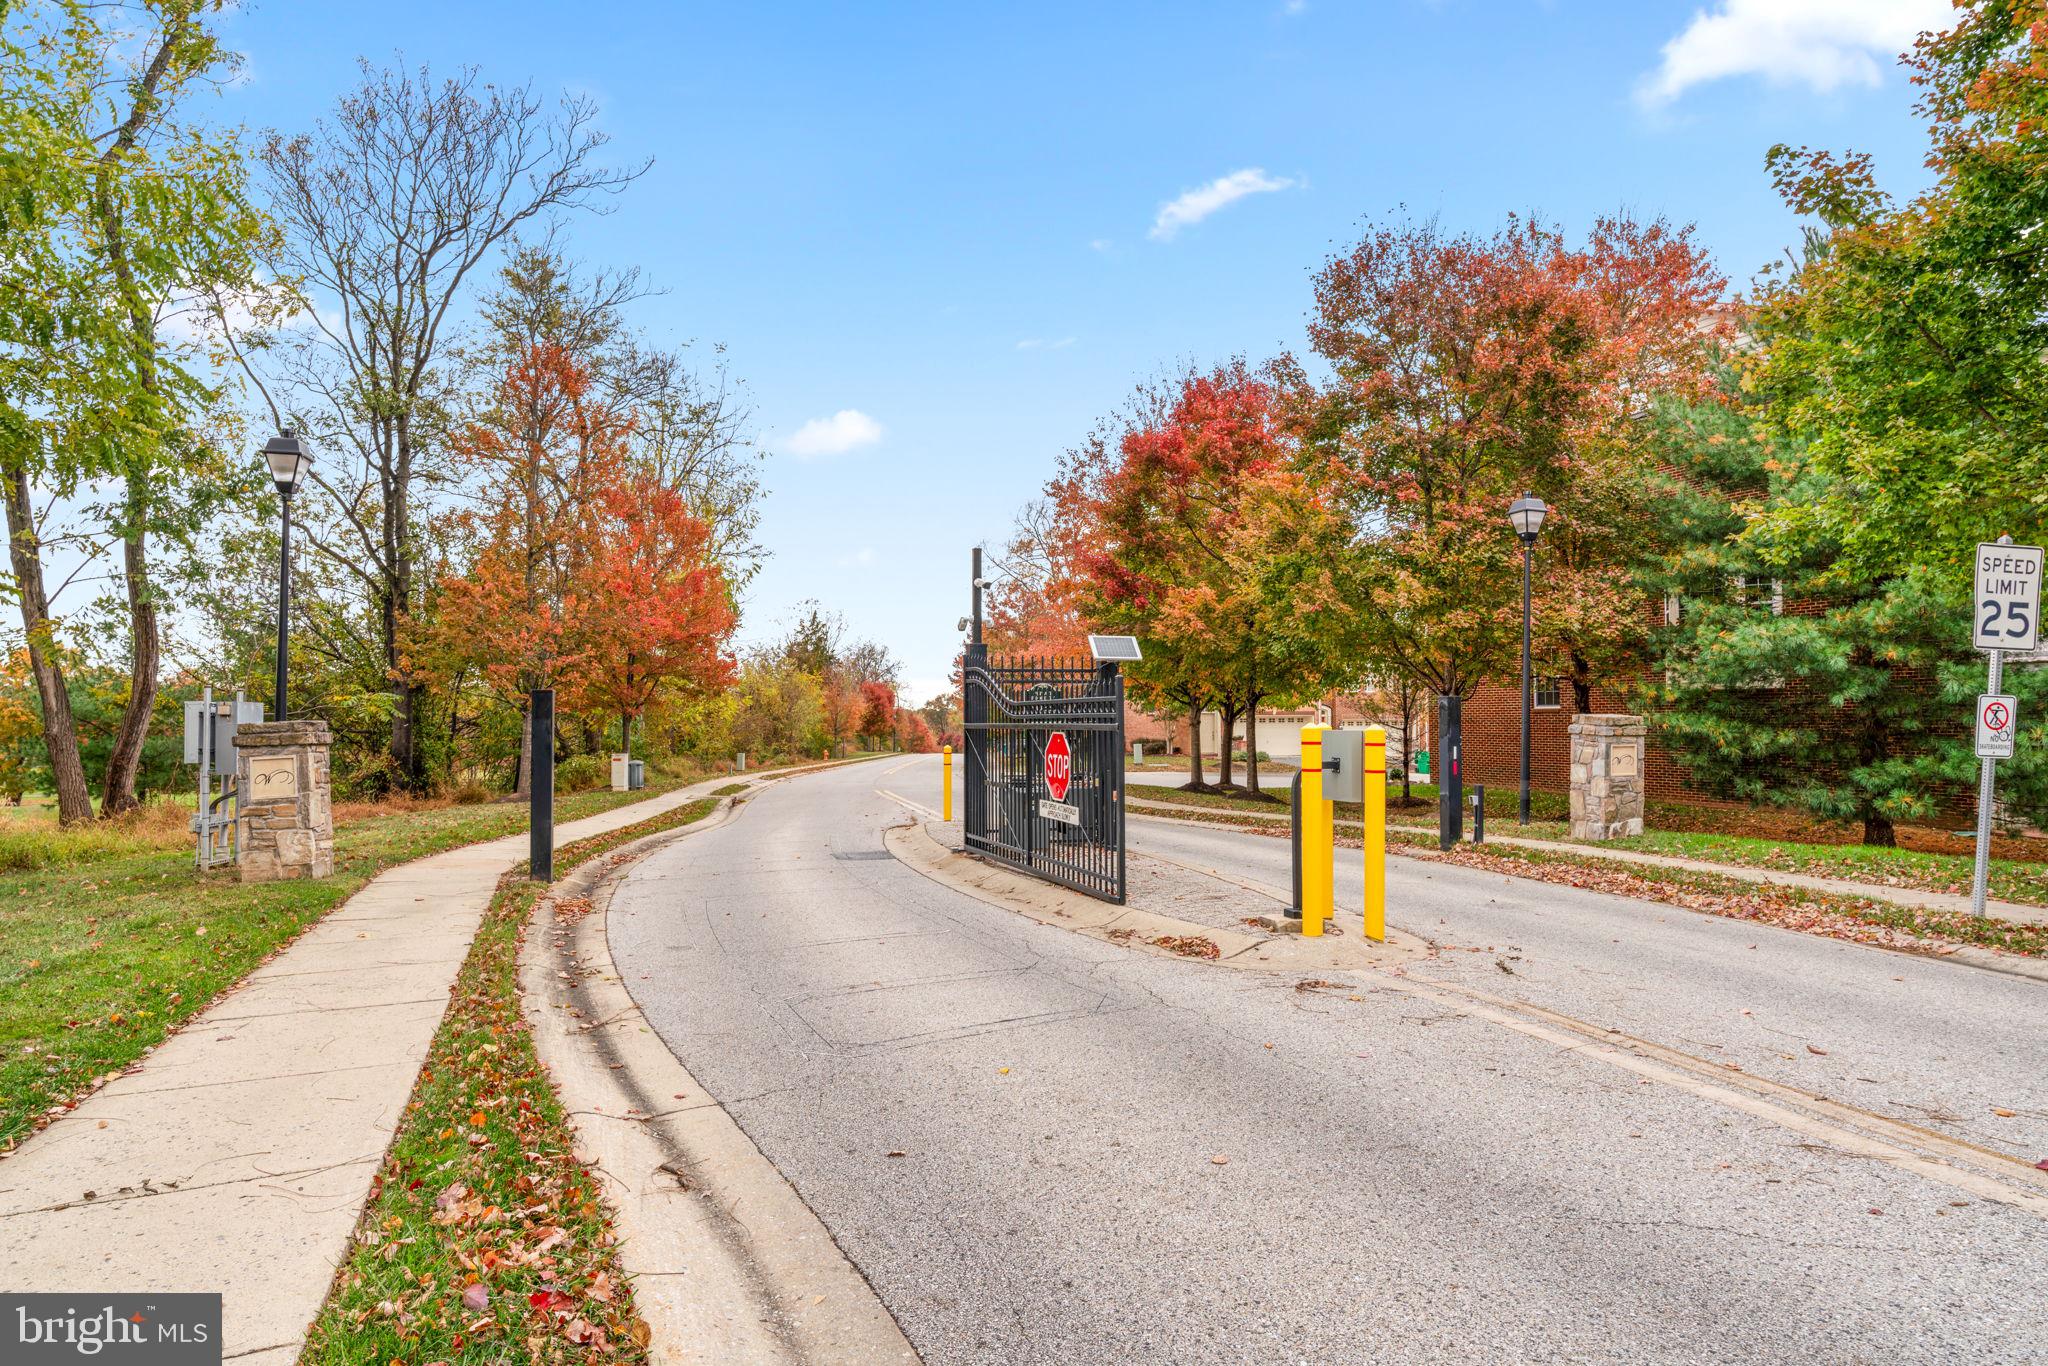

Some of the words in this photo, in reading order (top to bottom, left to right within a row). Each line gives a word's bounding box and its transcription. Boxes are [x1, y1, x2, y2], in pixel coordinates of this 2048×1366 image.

[1982, 557, 2036, 575] SPEED
[1985, 578, 2028, 595] LIMIT
[1981, 600, 2030, 638] 25
[1047, 753, 1069, 780] STOP
